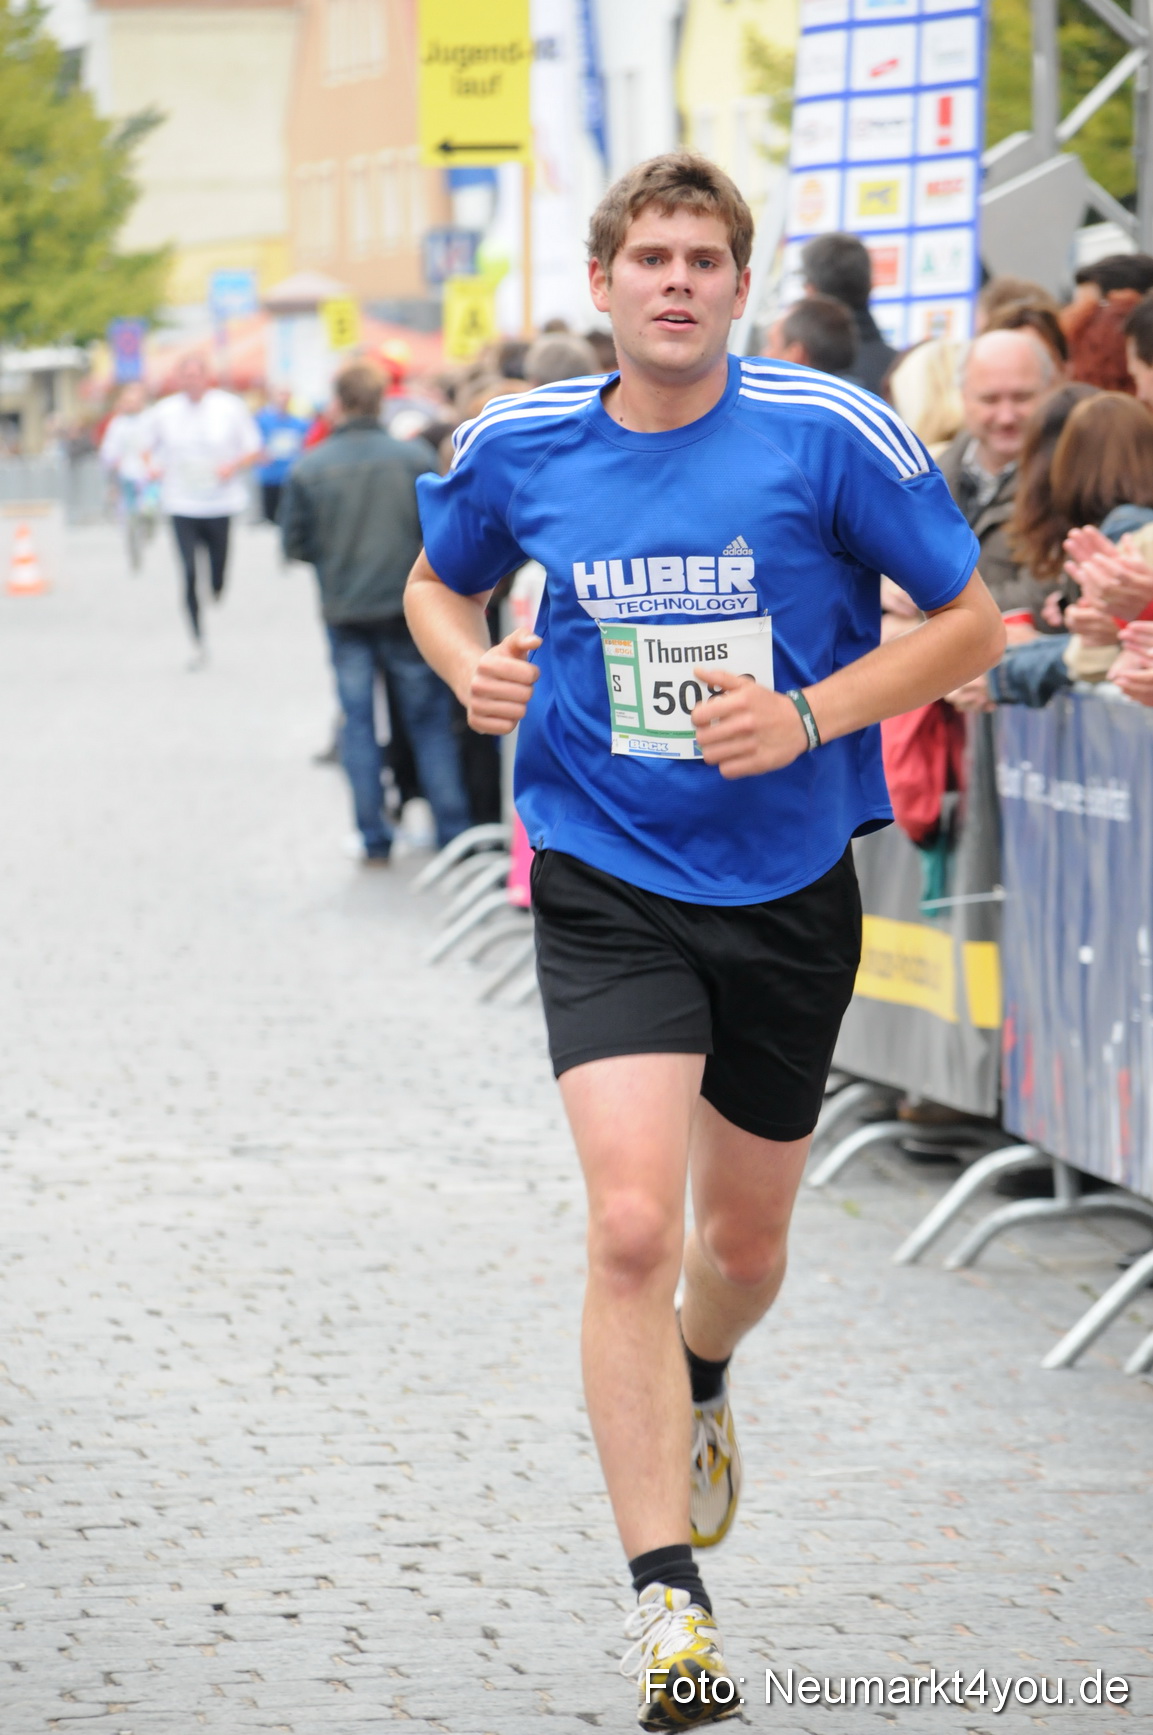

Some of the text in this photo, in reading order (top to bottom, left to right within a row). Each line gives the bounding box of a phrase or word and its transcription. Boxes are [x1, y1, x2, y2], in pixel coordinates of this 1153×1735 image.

[422, 40, 526, 72] Jugend-
[453, 73, 503, 98] lauf
[722, 548, 754, 556] adidas
[572, 556, 757, 599] HUBER
[615, 597, 749, 615] TECHNOLOGY
[644, 638, 729, 664] Thomas
[612, 674, 622, 693] S
[628, 738, 669, 752] BOCK
